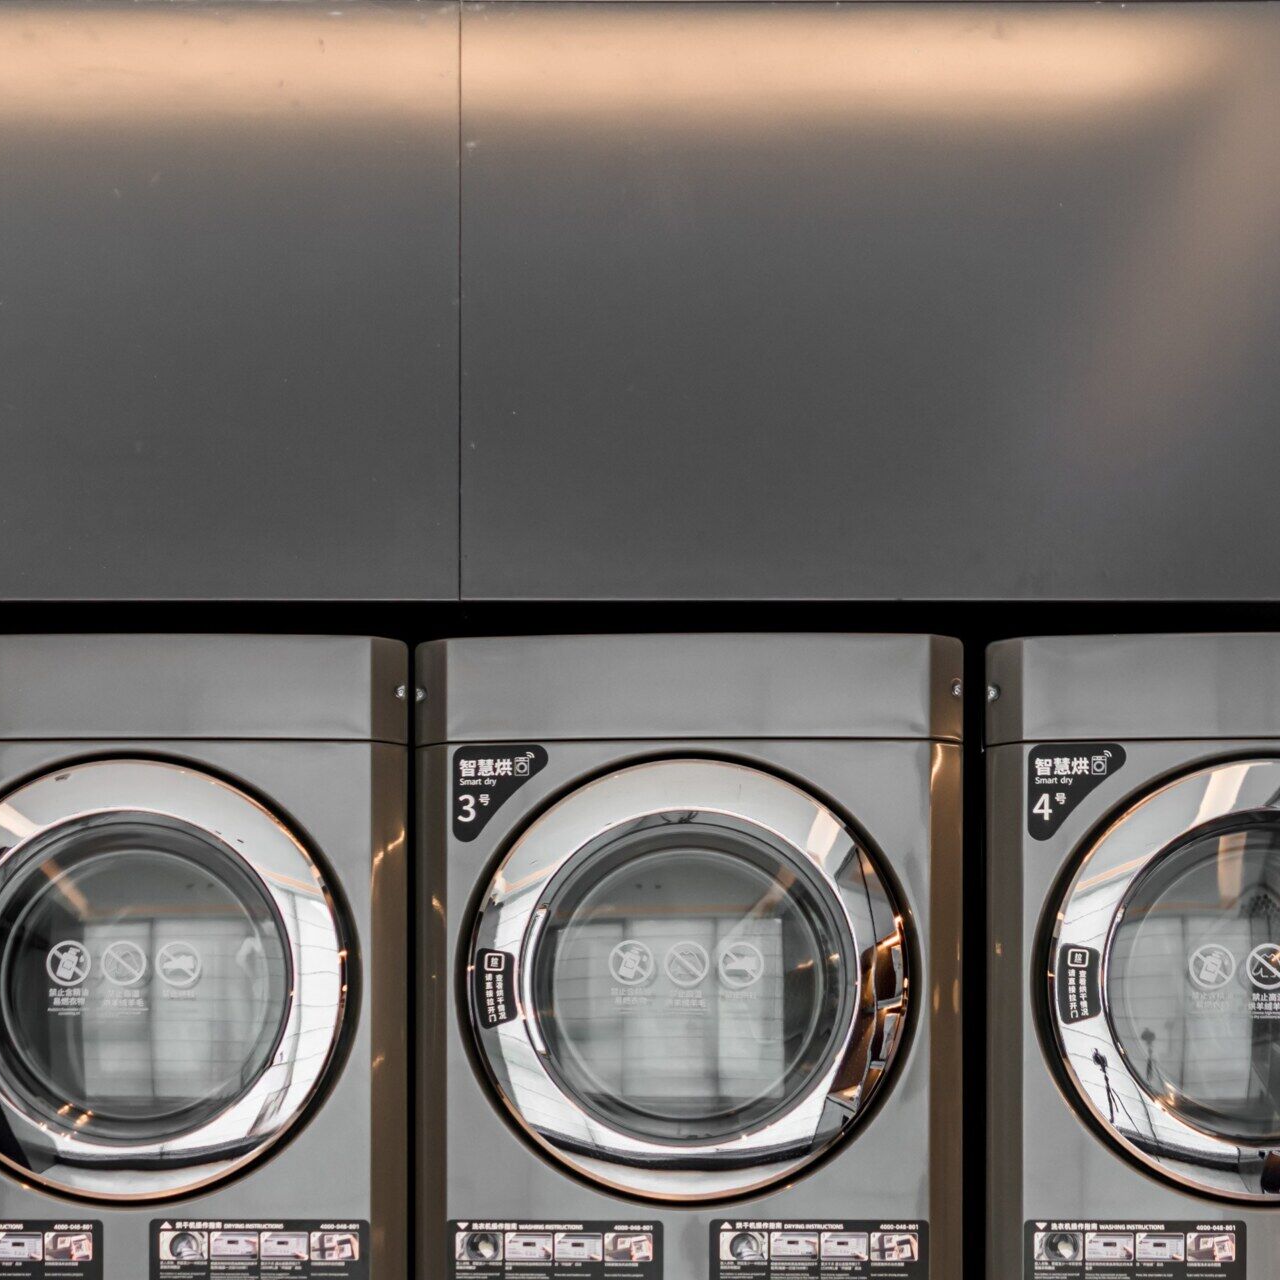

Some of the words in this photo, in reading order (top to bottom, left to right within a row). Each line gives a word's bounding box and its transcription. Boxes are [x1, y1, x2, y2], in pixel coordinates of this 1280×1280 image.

[459, 758, 512, 777] 智慧烘
[1035, 757, 1089, 776] 智慧烘
[460, 778, 482, 786] Smart
[484, 778, 497, 787] dry
[1035, 776, 1058, 785] Smart
[1060, 776, 1073, 785] dry
